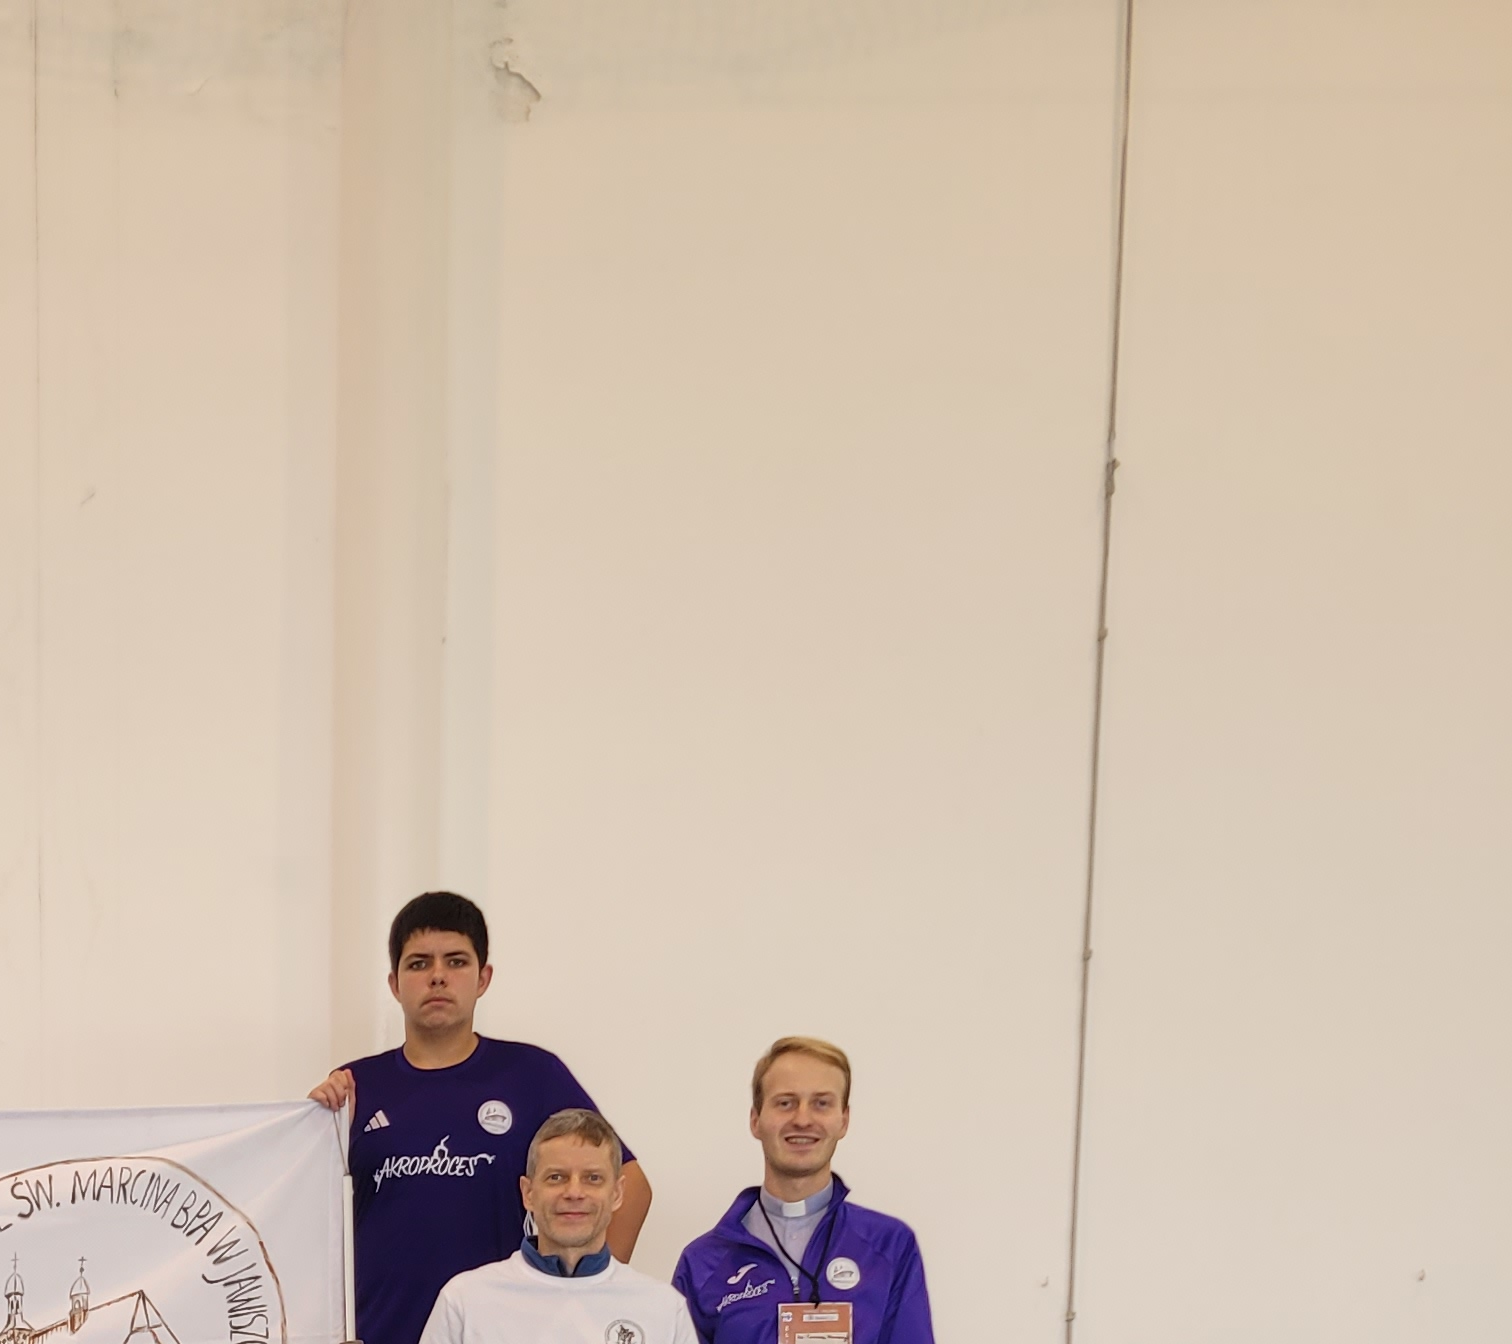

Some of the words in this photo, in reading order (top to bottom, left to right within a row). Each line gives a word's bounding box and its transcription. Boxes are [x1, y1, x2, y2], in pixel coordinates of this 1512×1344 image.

[376, 1150, 486, 1185] AKROPROCES
[10, 1173, 61, 1219] ŚW.
[70, 1166, 181, 1220] MARCINA
[170, 1190, 223, 1246] BPA
[206, 1225, 249, 1265] W
